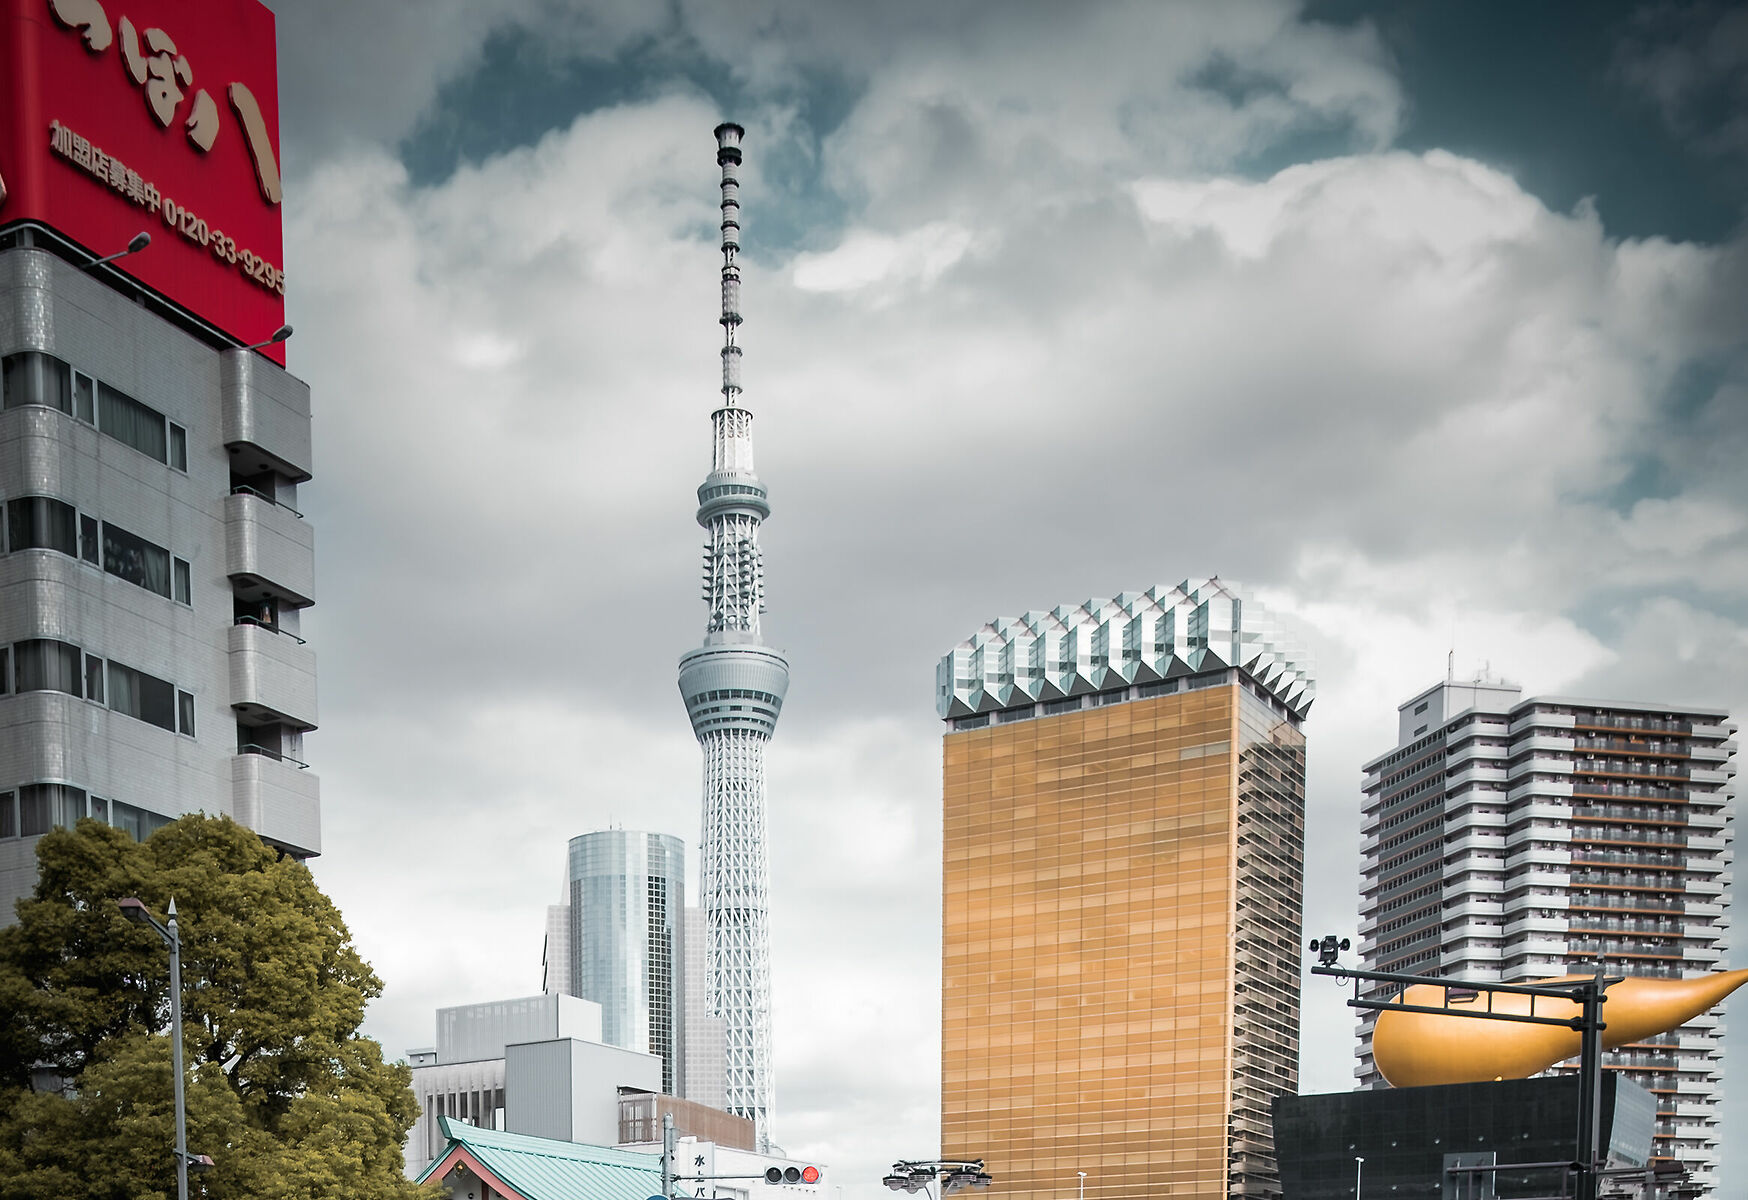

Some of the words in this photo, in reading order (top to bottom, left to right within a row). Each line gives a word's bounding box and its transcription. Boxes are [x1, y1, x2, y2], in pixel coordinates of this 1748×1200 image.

[49, 119, 161, 213] 加盟店募集中
[163, 198, 285, 295] 0120-33-9295
